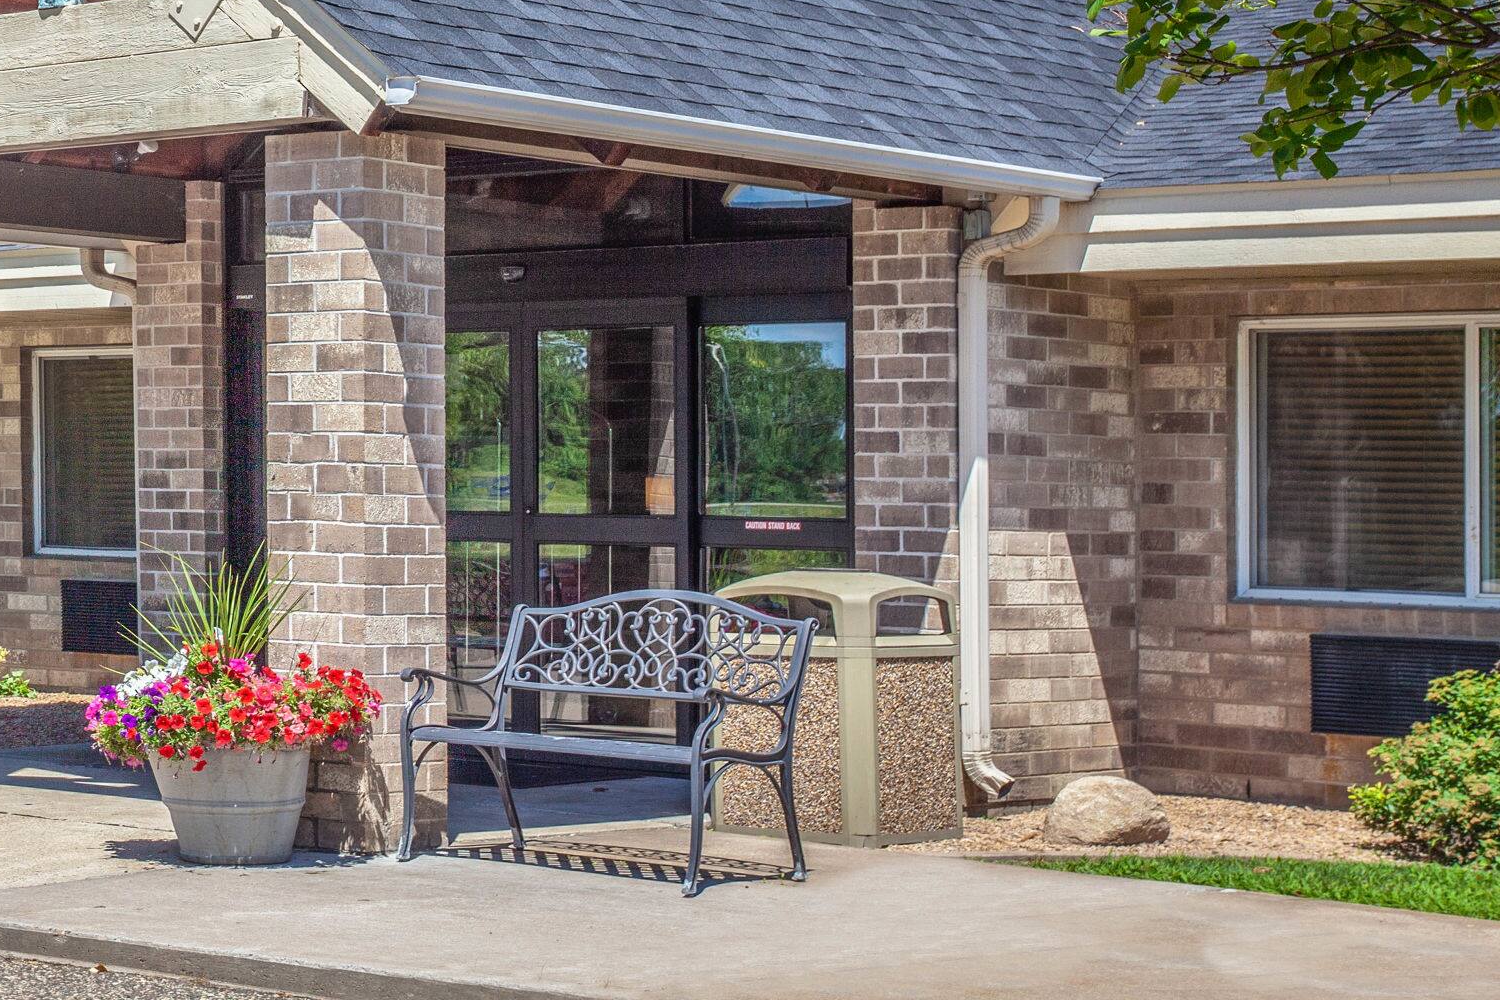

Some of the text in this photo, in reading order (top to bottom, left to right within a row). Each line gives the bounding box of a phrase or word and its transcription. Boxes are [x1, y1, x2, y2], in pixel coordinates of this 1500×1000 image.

[745, 521, 801, 530] CAUTION STAND BACK
